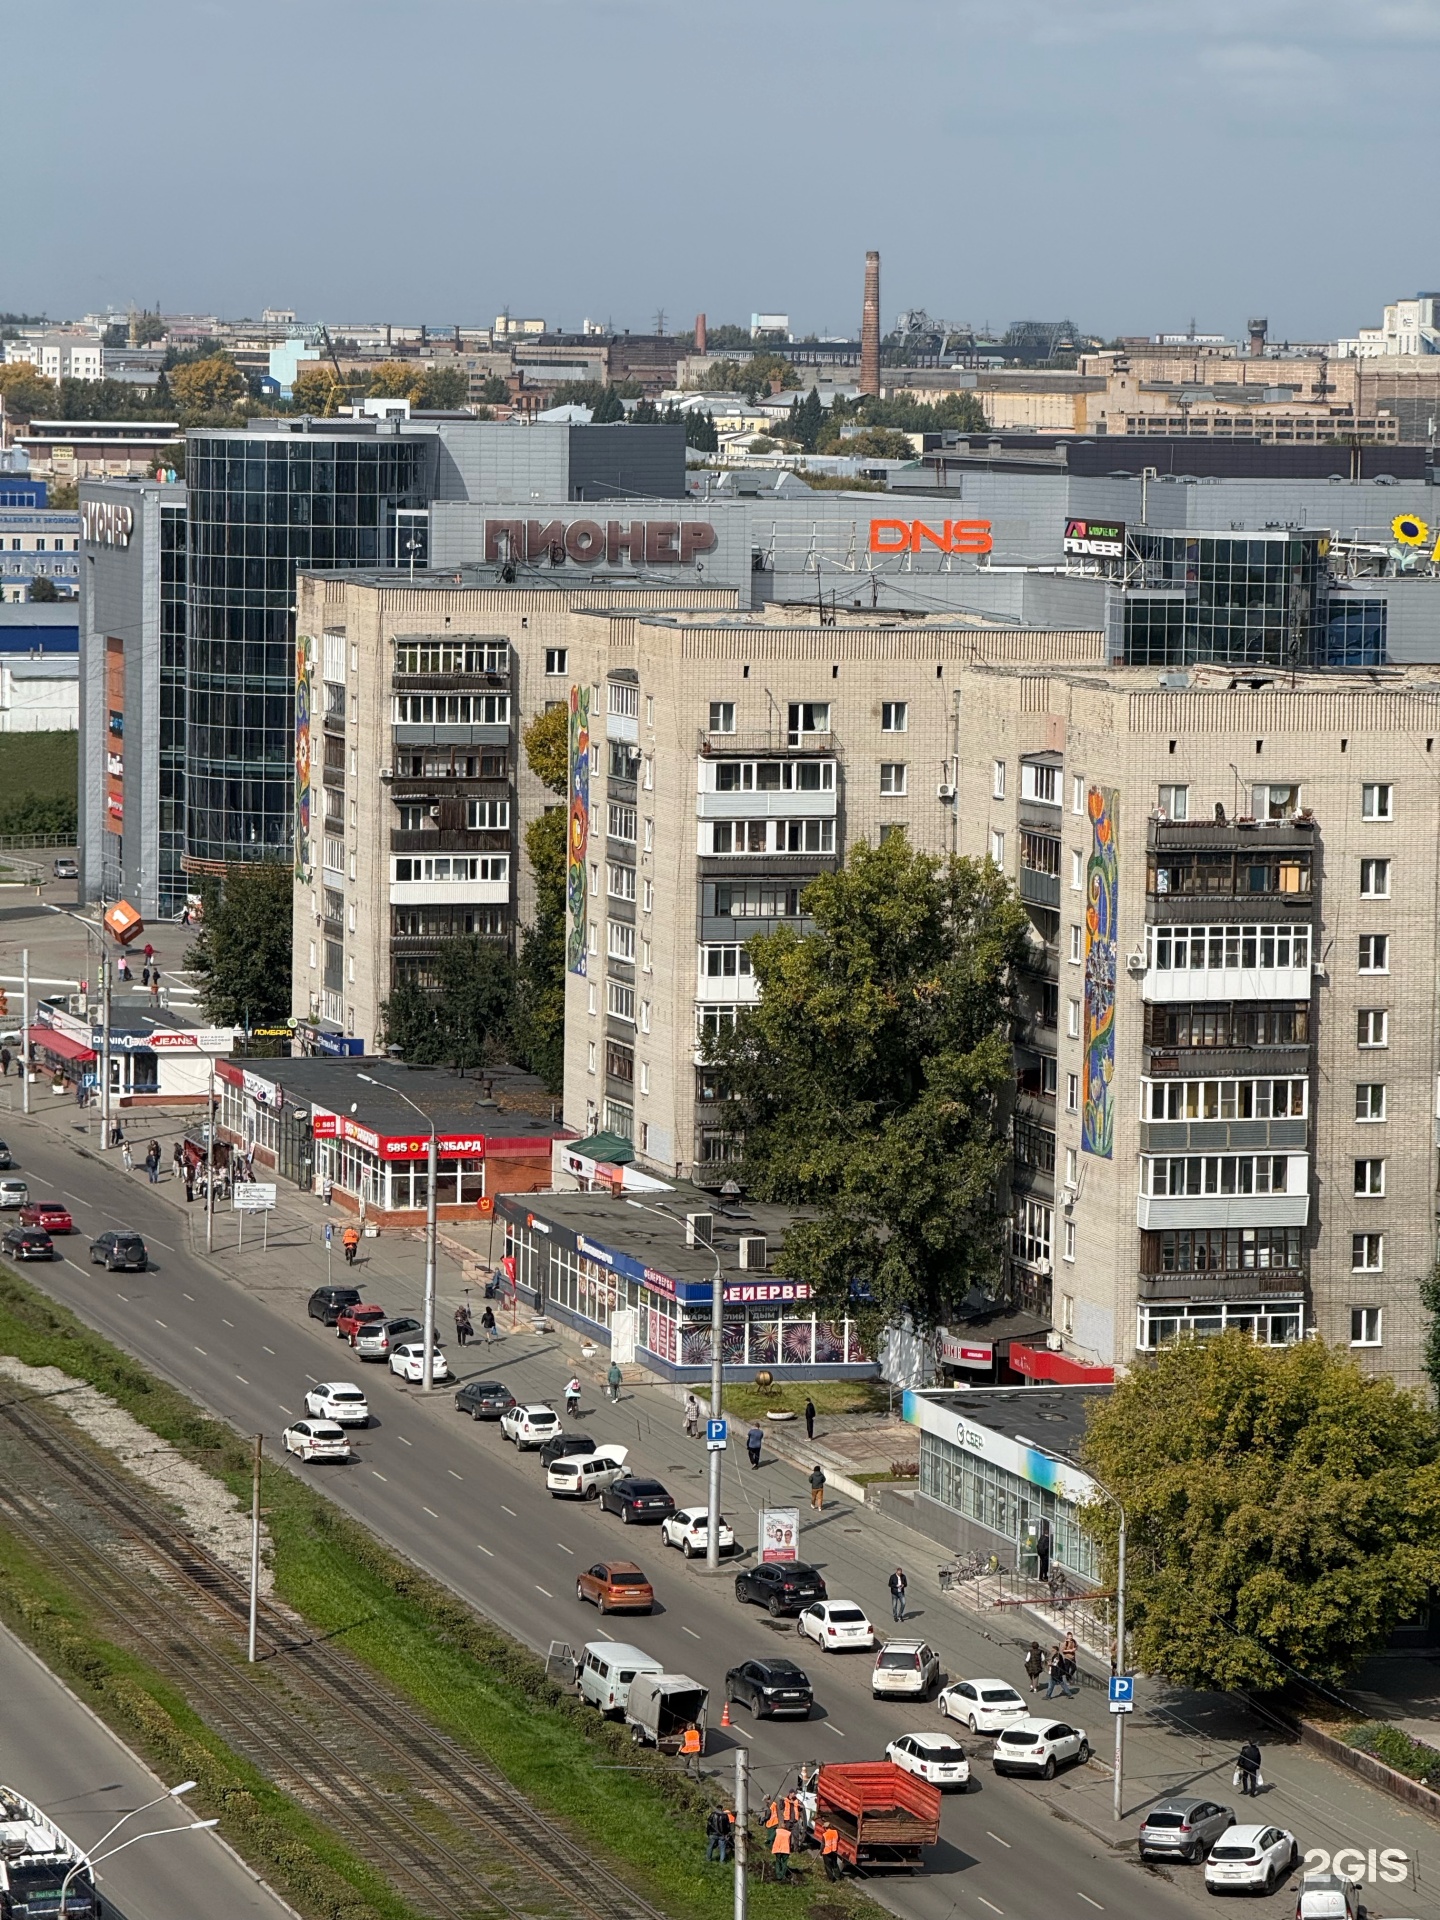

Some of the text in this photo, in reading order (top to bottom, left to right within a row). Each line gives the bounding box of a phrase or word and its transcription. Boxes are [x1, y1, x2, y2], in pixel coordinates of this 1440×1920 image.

[484, 519, 717, 562] ПИОНЕР
[870, 519, 994, 553] DNS
[112, 910, 130, 925] 1
[93, 1036, 124, 1045] DNIM
[254, 1029, 292, 1037] ЛОМБАРД
[155, 1037, 193, 1045] JEANS
[386, 1140, 481, 1152] 585 ЛМБАРД
[712, 1422, 723, 1438] P
[1115, 1680, 1128, 1698] P
